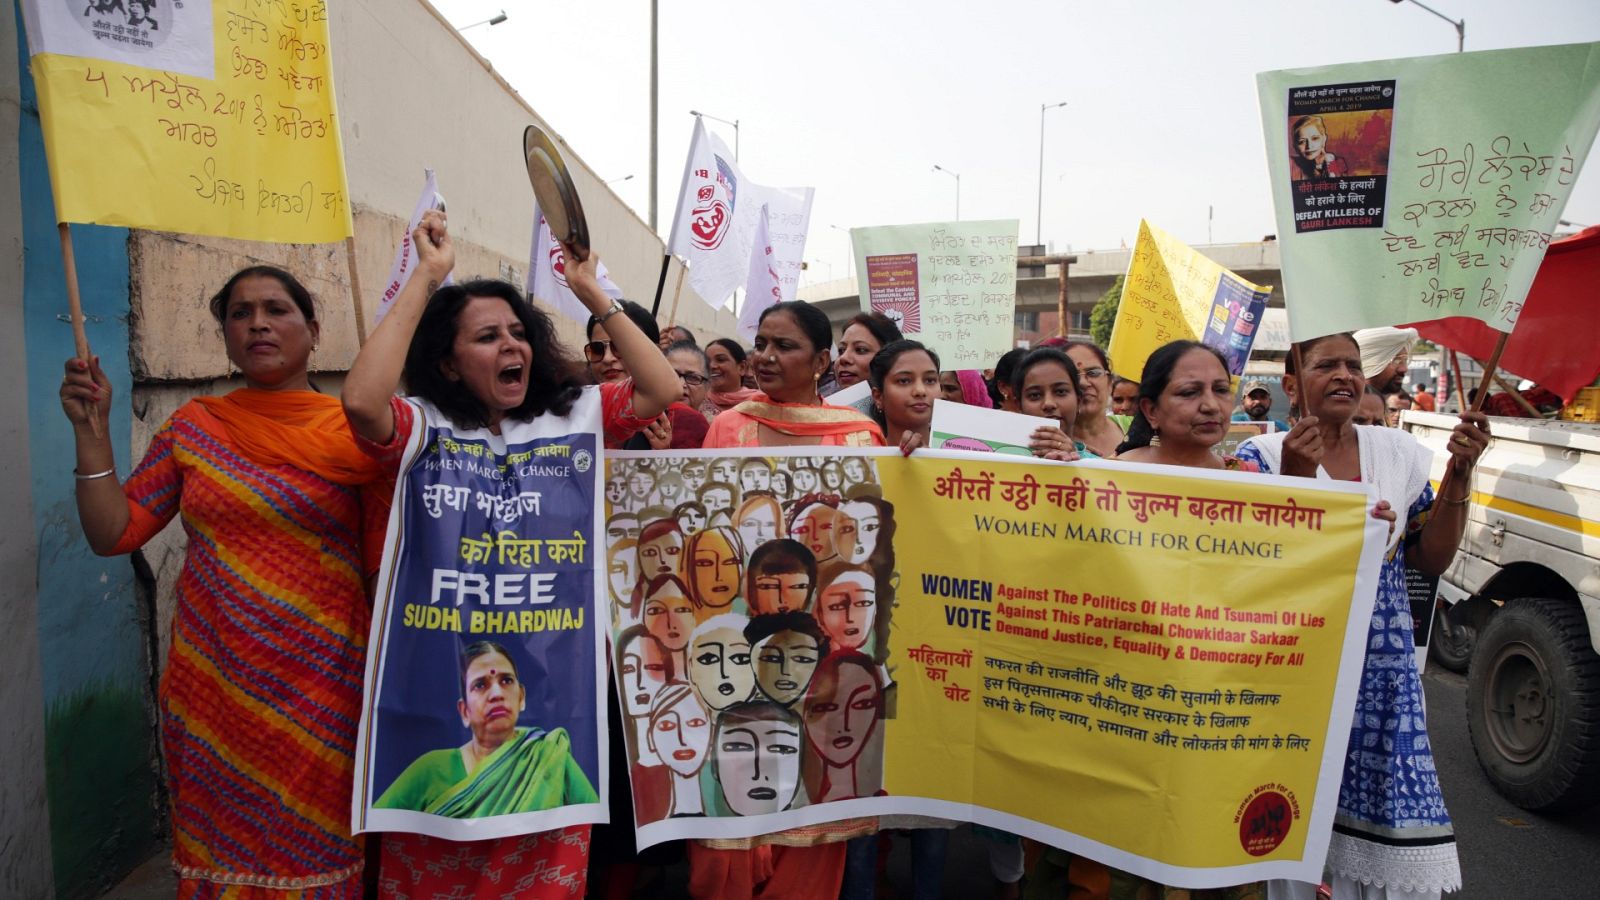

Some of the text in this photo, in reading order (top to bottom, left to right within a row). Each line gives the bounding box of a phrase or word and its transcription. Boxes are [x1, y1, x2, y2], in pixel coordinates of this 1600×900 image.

[1338, 180, 1348, 190] के
[1347, 192, 1365, 204] लिए
[1296, 207, 1382, 221] DEFEAT KILLERS OF
[1301, 217, 1372, 229] GAURI LANKESH
[533, 444, 571, 459] जायेगा
[520, 465, 571, 479] CHANGE
[423, 484, 471, 519] सुधा
[933, 467, 995, 501] औरतें
[1045, 477, 1090, 512] नहीं
[1094, 480, 1122, 512] तो
[1126, 491, 1183, 524] जुल्म
[1187, 496, 1247, 526] बढ़ता
[1251, 497, 1326, 531] जायेगा
[461, 530, 586, 568] को रिहा करो
[974, 514, 1283, 559] WOMEN MARCH FOR CHANGE
[431, 568, 558, 606] FREE
[921, 573, 993, 603] WOMEN
[470, 607, 584, 634] BHARDWAJ
[944, 605, 991, 632] VOTE
[997, 584, 1326, 628] Against The Politics Of Hate And Tsunami Of Lies
[996, 602, 1299, 646] Against This Patriarchal Chowkidaar Sarkaar
[907, 644, 973, 668] महिलायों
[996, 620, 1304, 667] Demand Justice, Equality & Democracy For All
[925, 666, 948, 683] का
[984, 656, 1282, 708] नफरत की राजनीति और झूठ की सुनामी के खिलाफ
[943, 682, 972, 702] वोट
[983, 676, 1004, 691] इस
[1087, 691, 1139, 718] चौकीदार
[1143, 707, 1190, 727] सरकार
[1193, 711, 1208, 729] के
[1210, 711, 1252, 729] खिलाफ
[983, 695, 1311, 752] सभी के लिए न्याय, समानता और लोकतंत्र की मांग के लिए
[1233, 782, 1300, 824] Women March for Change
